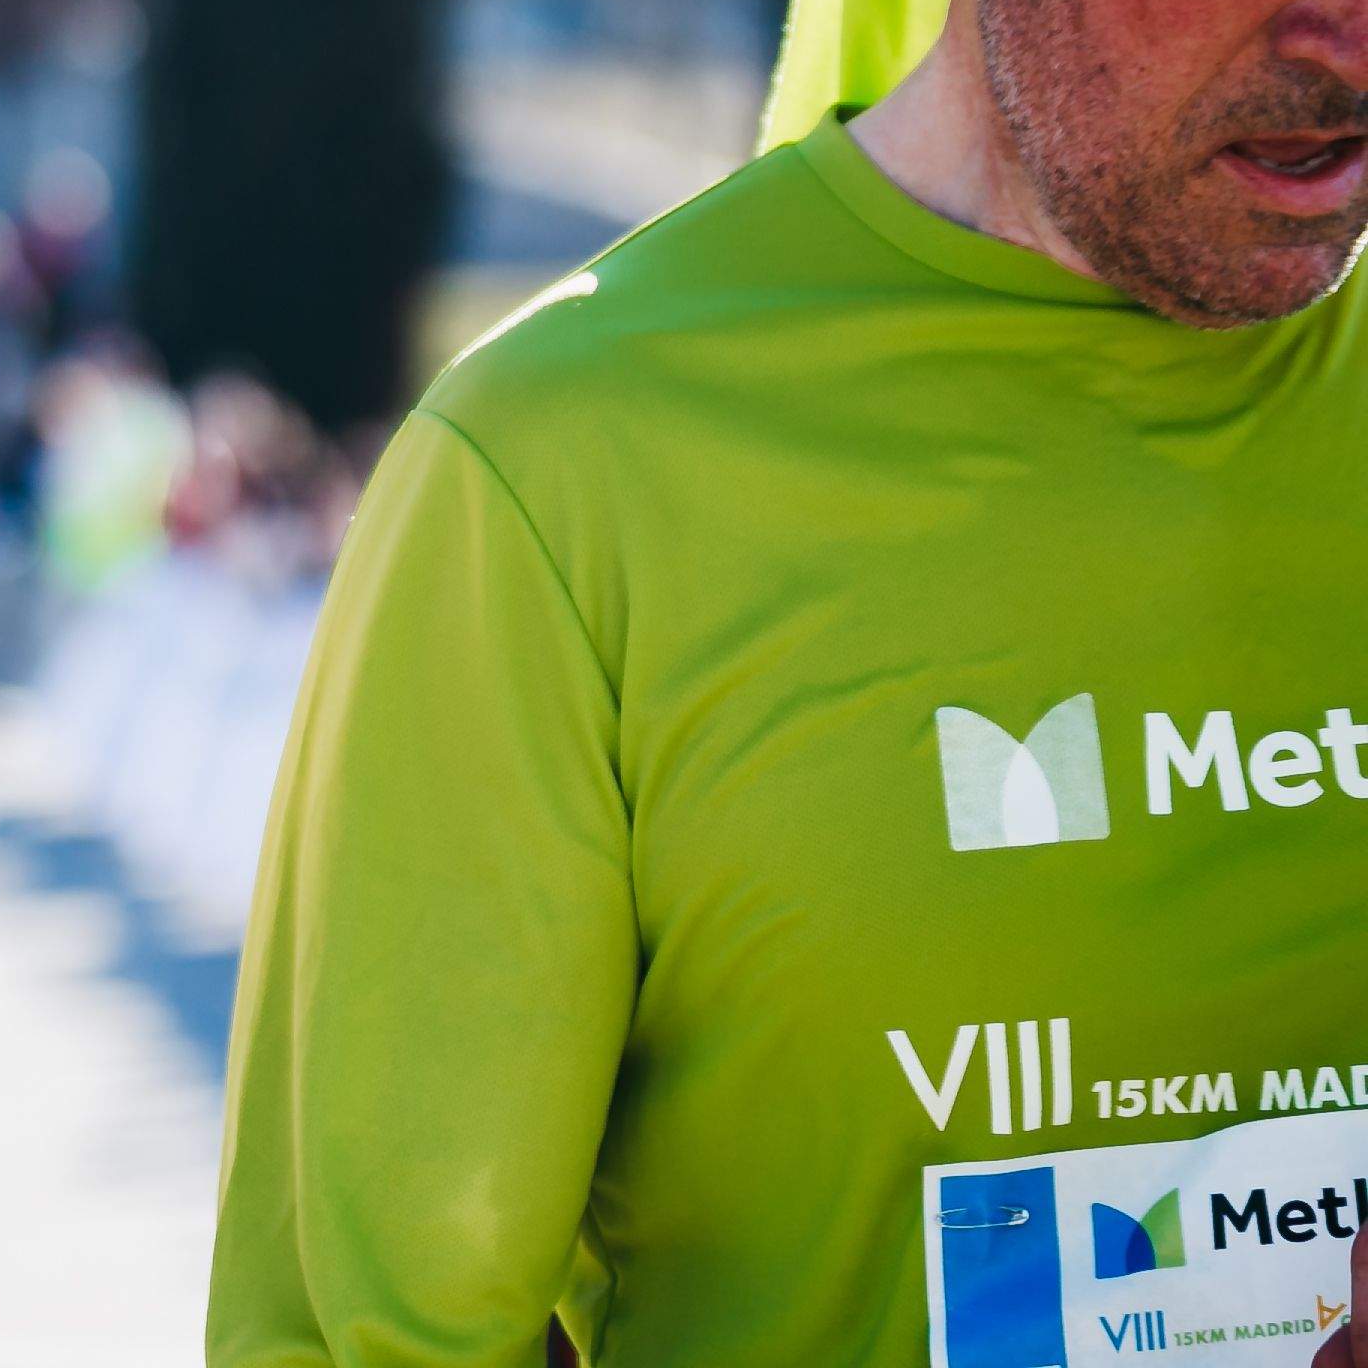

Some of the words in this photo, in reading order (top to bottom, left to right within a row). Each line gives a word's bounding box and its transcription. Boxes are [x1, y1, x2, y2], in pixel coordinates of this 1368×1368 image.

[884, 1017, 1073, 1135] VIII
[1091, 1072, 1239, 1119] 15KM
[1099, 1310, 1166, 1353] VIII
[1174, 1327, 1228, 1347] 15KM
